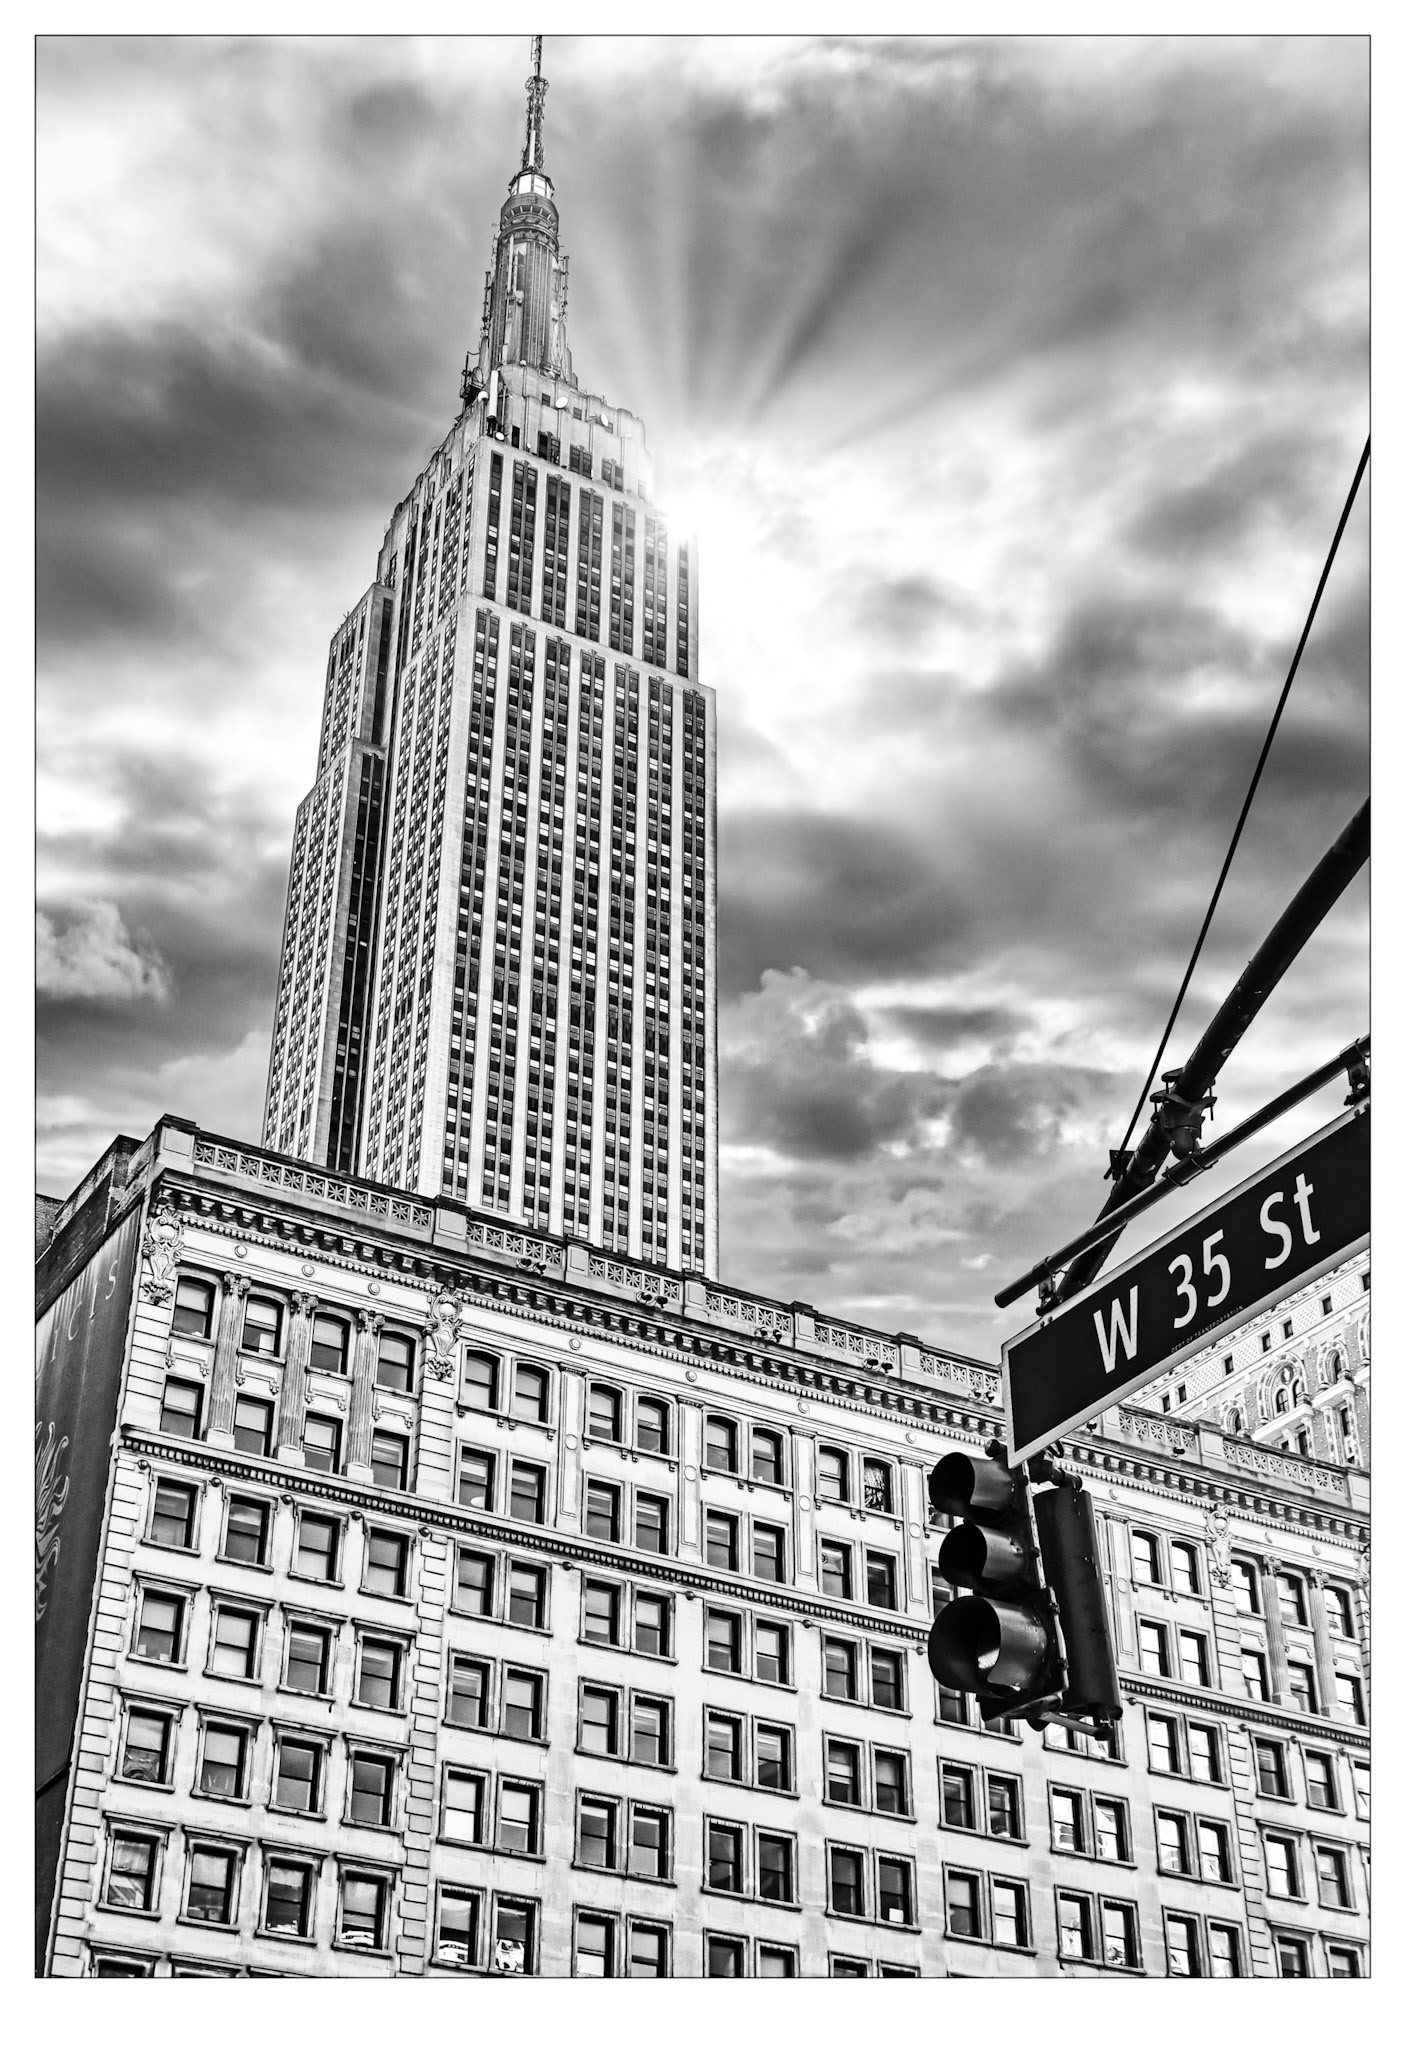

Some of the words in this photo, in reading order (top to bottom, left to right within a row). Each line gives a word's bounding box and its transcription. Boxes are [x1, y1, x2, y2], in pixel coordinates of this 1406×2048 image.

[1093, 1285, 1138, 1374] W
[1168, 1229, 1231, 1329] 35
[1260, 1173, 1321, 1270] St
[1194, 1305, 1243, 1337] TRANSPORTATION
